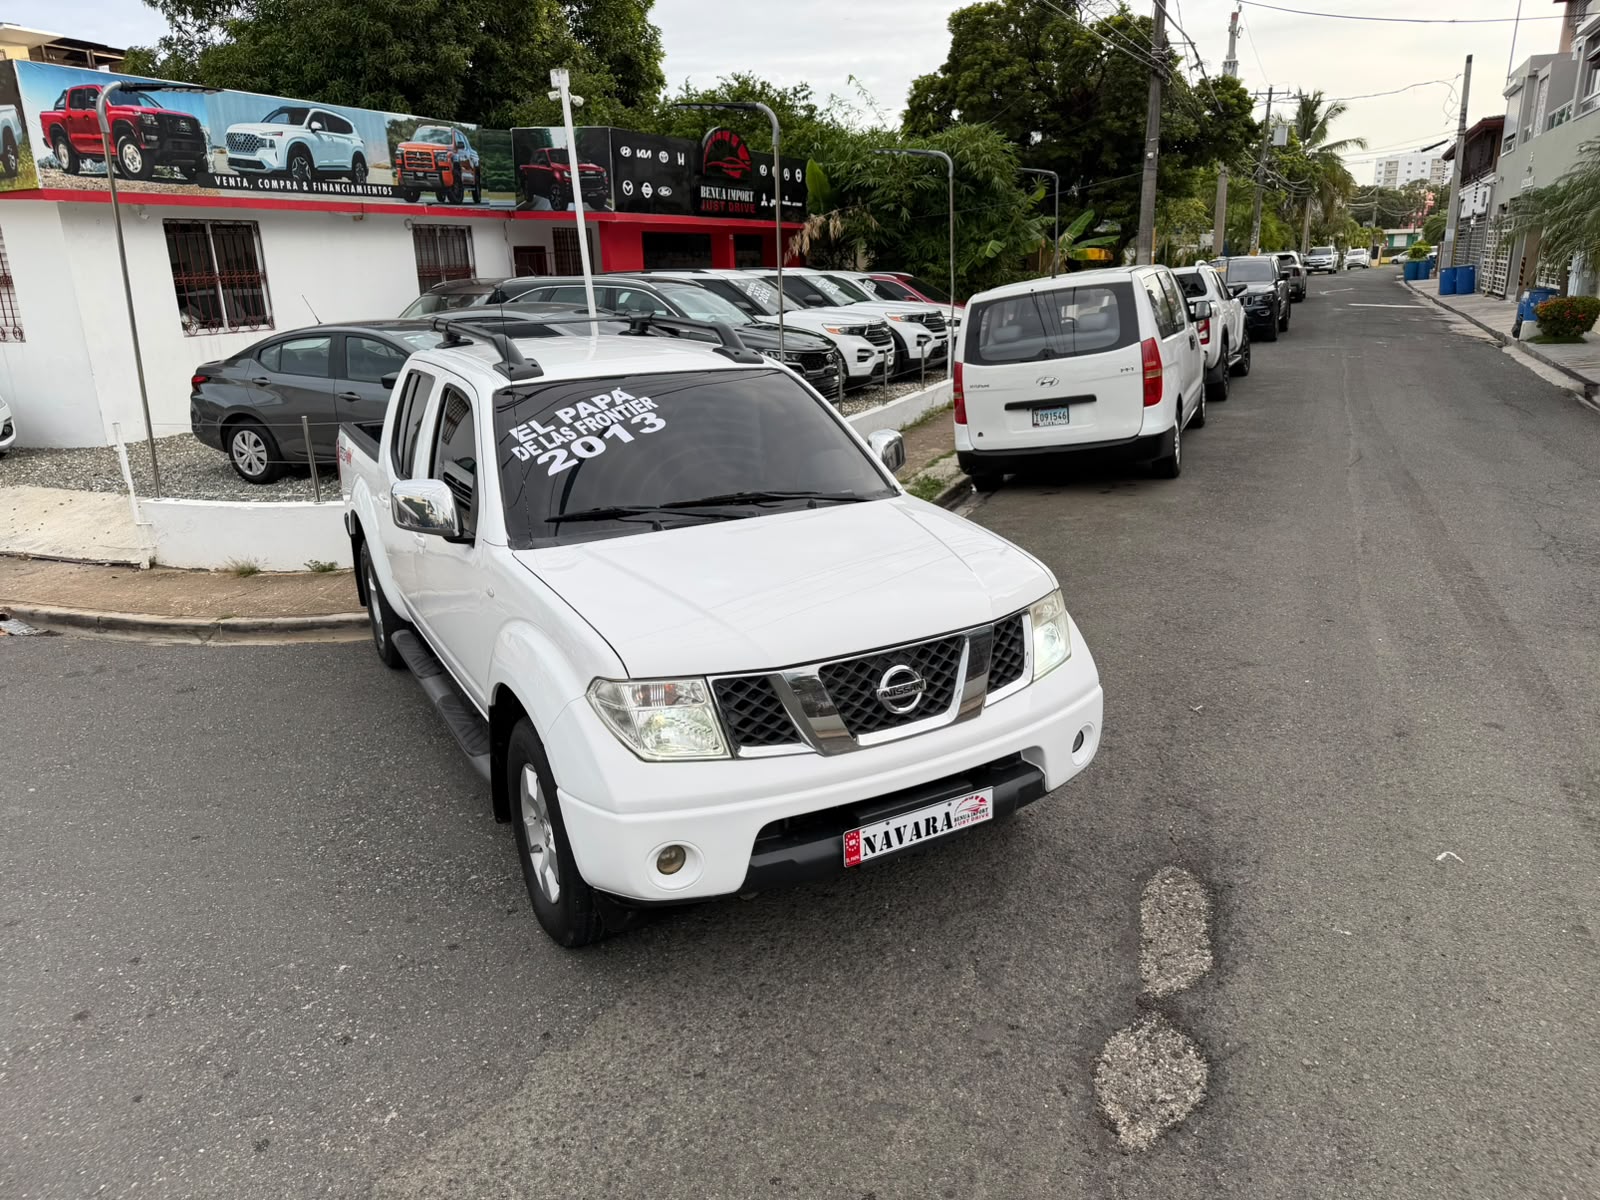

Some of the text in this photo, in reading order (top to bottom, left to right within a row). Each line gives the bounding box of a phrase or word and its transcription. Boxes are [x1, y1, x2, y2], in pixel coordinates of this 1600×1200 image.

[214, 175, 393, 195] VENTA, COMPRA & FINANCIAMIENTOS
[700, 185, 754, 202] BENUA IMPORT
[701, 200, 725, 212] JUST
[728, 202, 757, 214] DRIVE
[508, 420, 556, 443] EL
[510, 396, 659, 461] DE LAS FRONTIER
[536, 411, 667, 477] 2013
[880, 683, 923, 698] NISSAN
[862, 811, 954, 857] NAVARA
